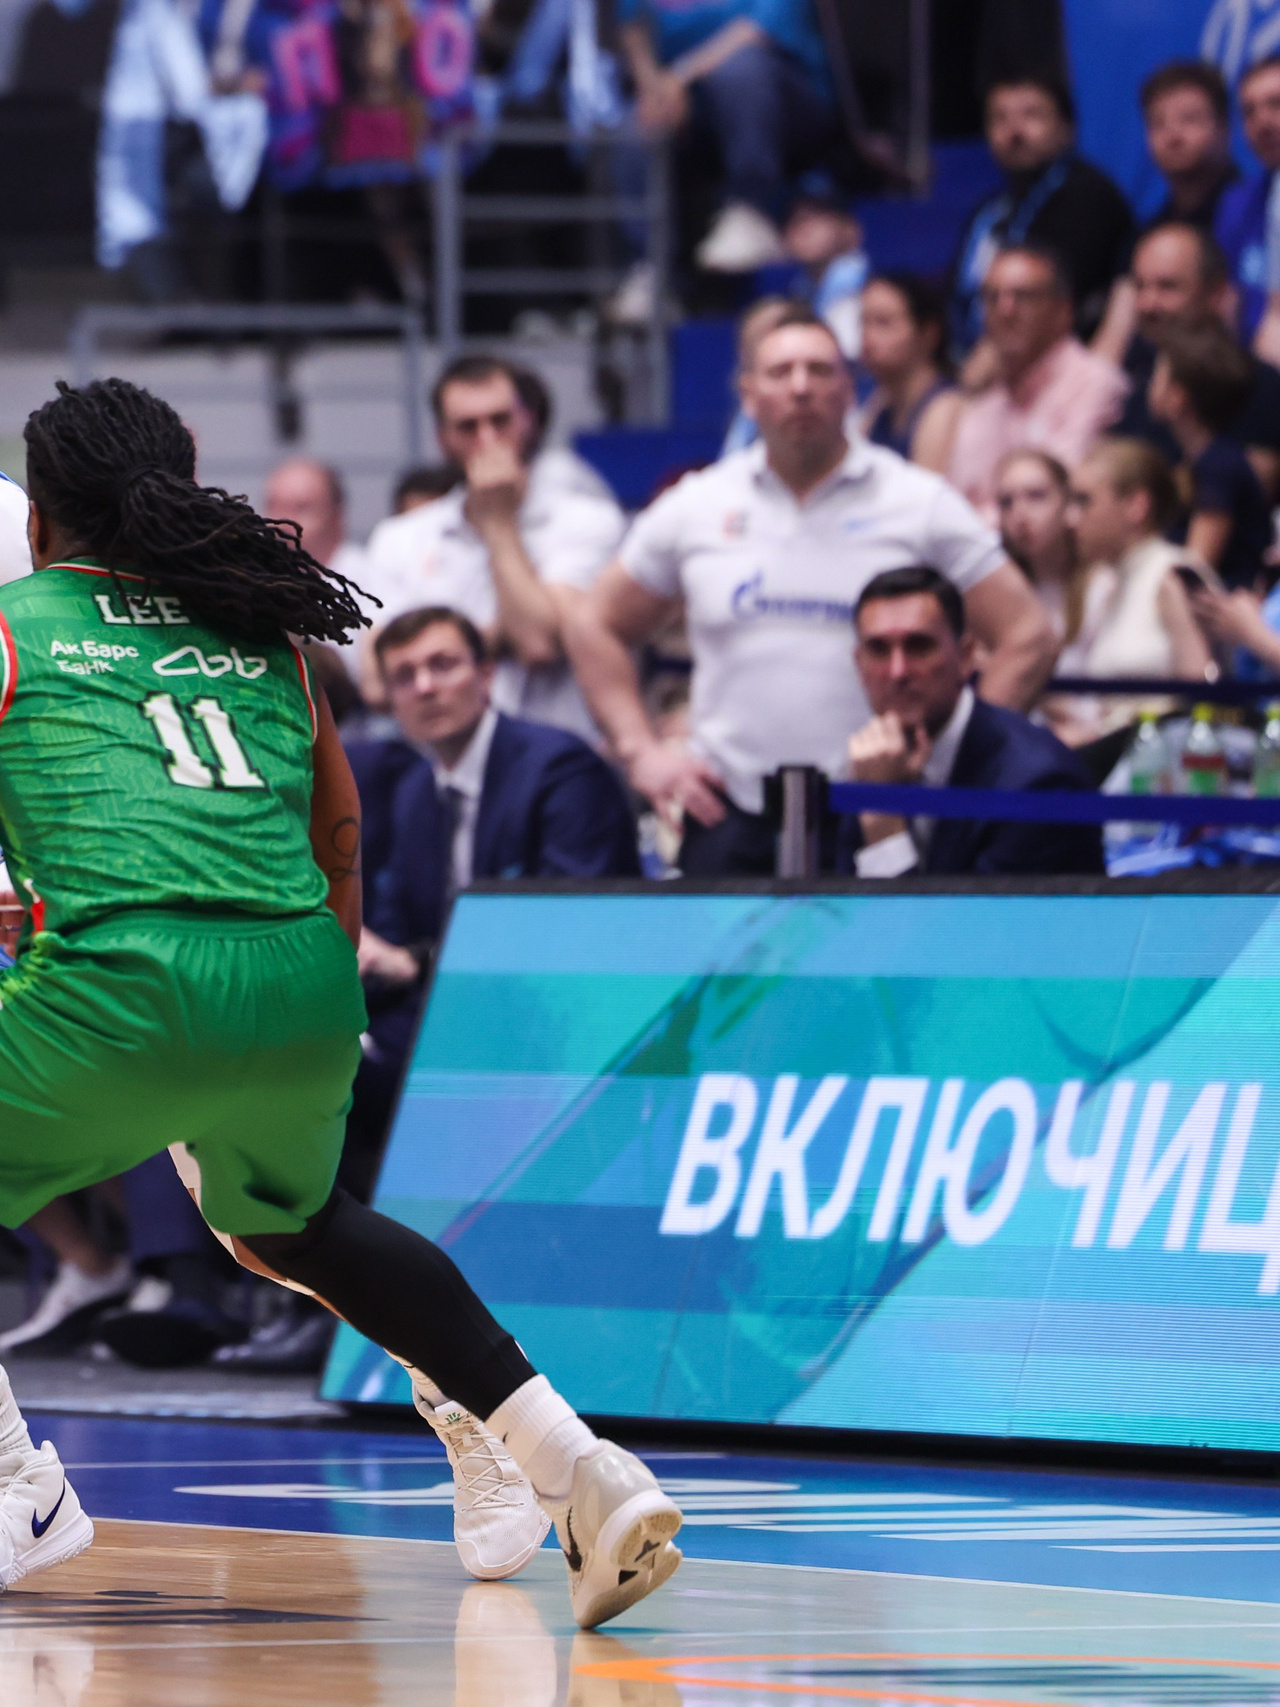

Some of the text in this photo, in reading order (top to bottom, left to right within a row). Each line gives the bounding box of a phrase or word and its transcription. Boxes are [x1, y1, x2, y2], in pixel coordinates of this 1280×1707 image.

[93, 594, 191, 625] LEE
[51, 639, 140, 661] Ак Барс
[141, 692, 267, 790] 11
